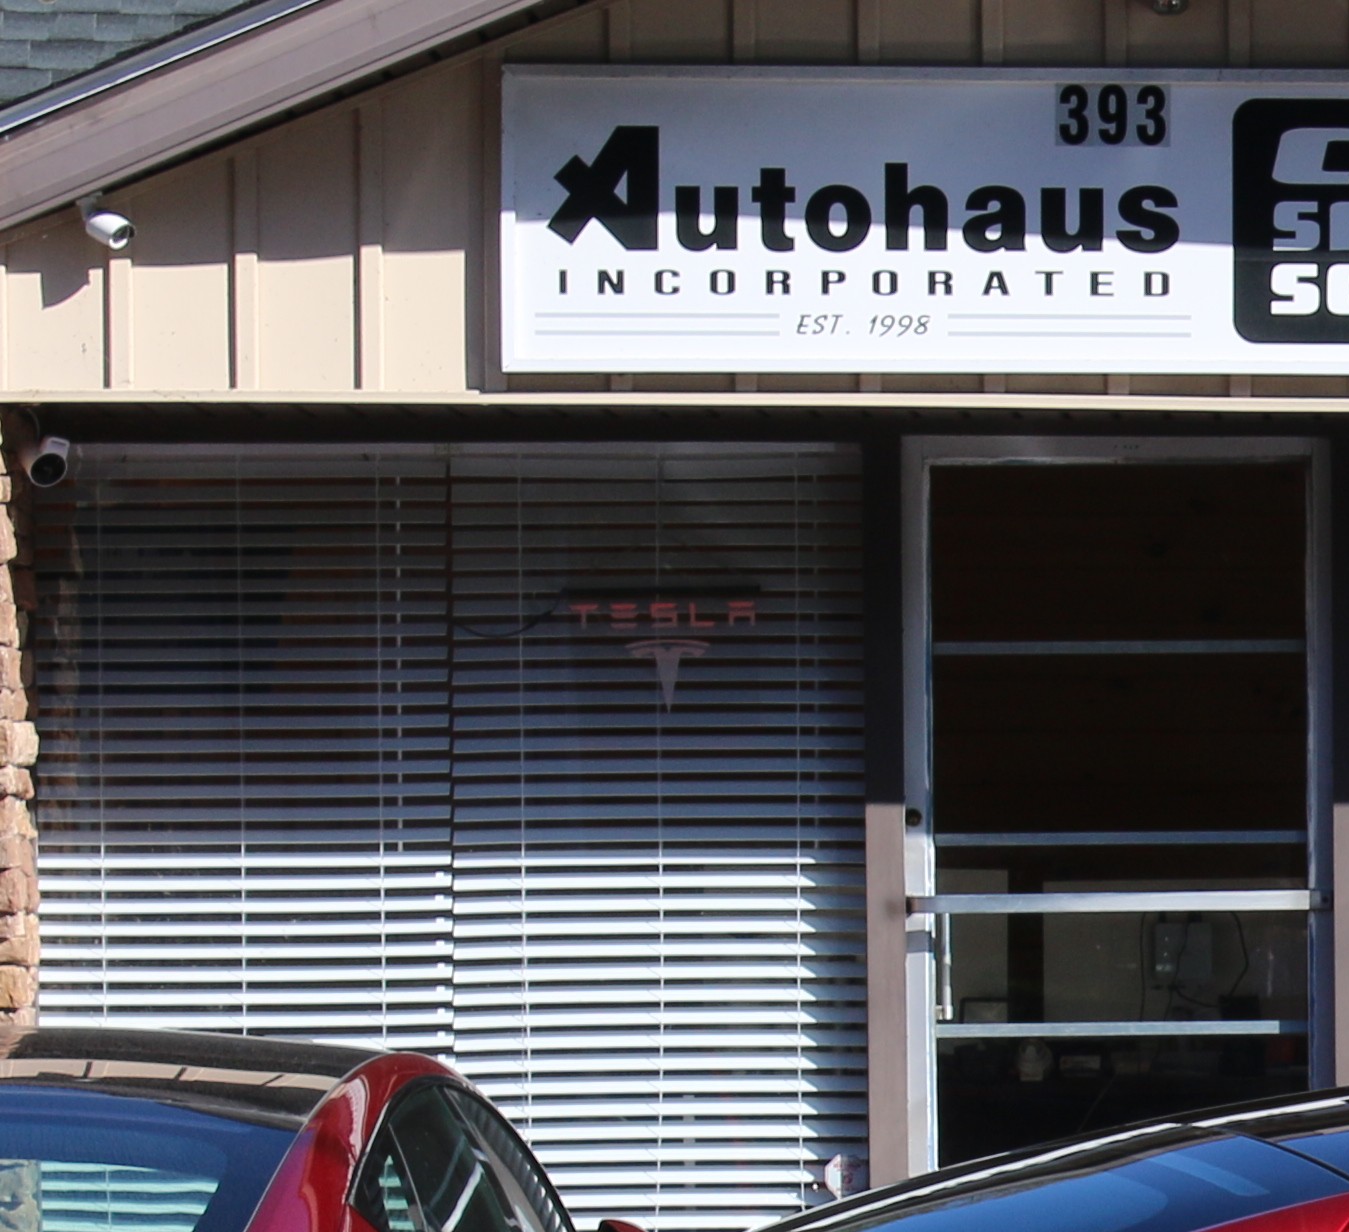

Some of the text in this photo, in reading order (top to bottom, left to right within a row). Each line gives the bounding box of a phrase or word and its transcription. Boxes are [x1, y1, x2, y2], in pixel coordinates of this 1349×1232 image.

[1058, 83, 1166, 146] 393
[547, 125, 1180, 254] Autohaus
[558, 268, 1171, 297] INCORPORATED
[796, 314, 931, 338] EST. 1998
[568, 602, 757, 629] TESLA
